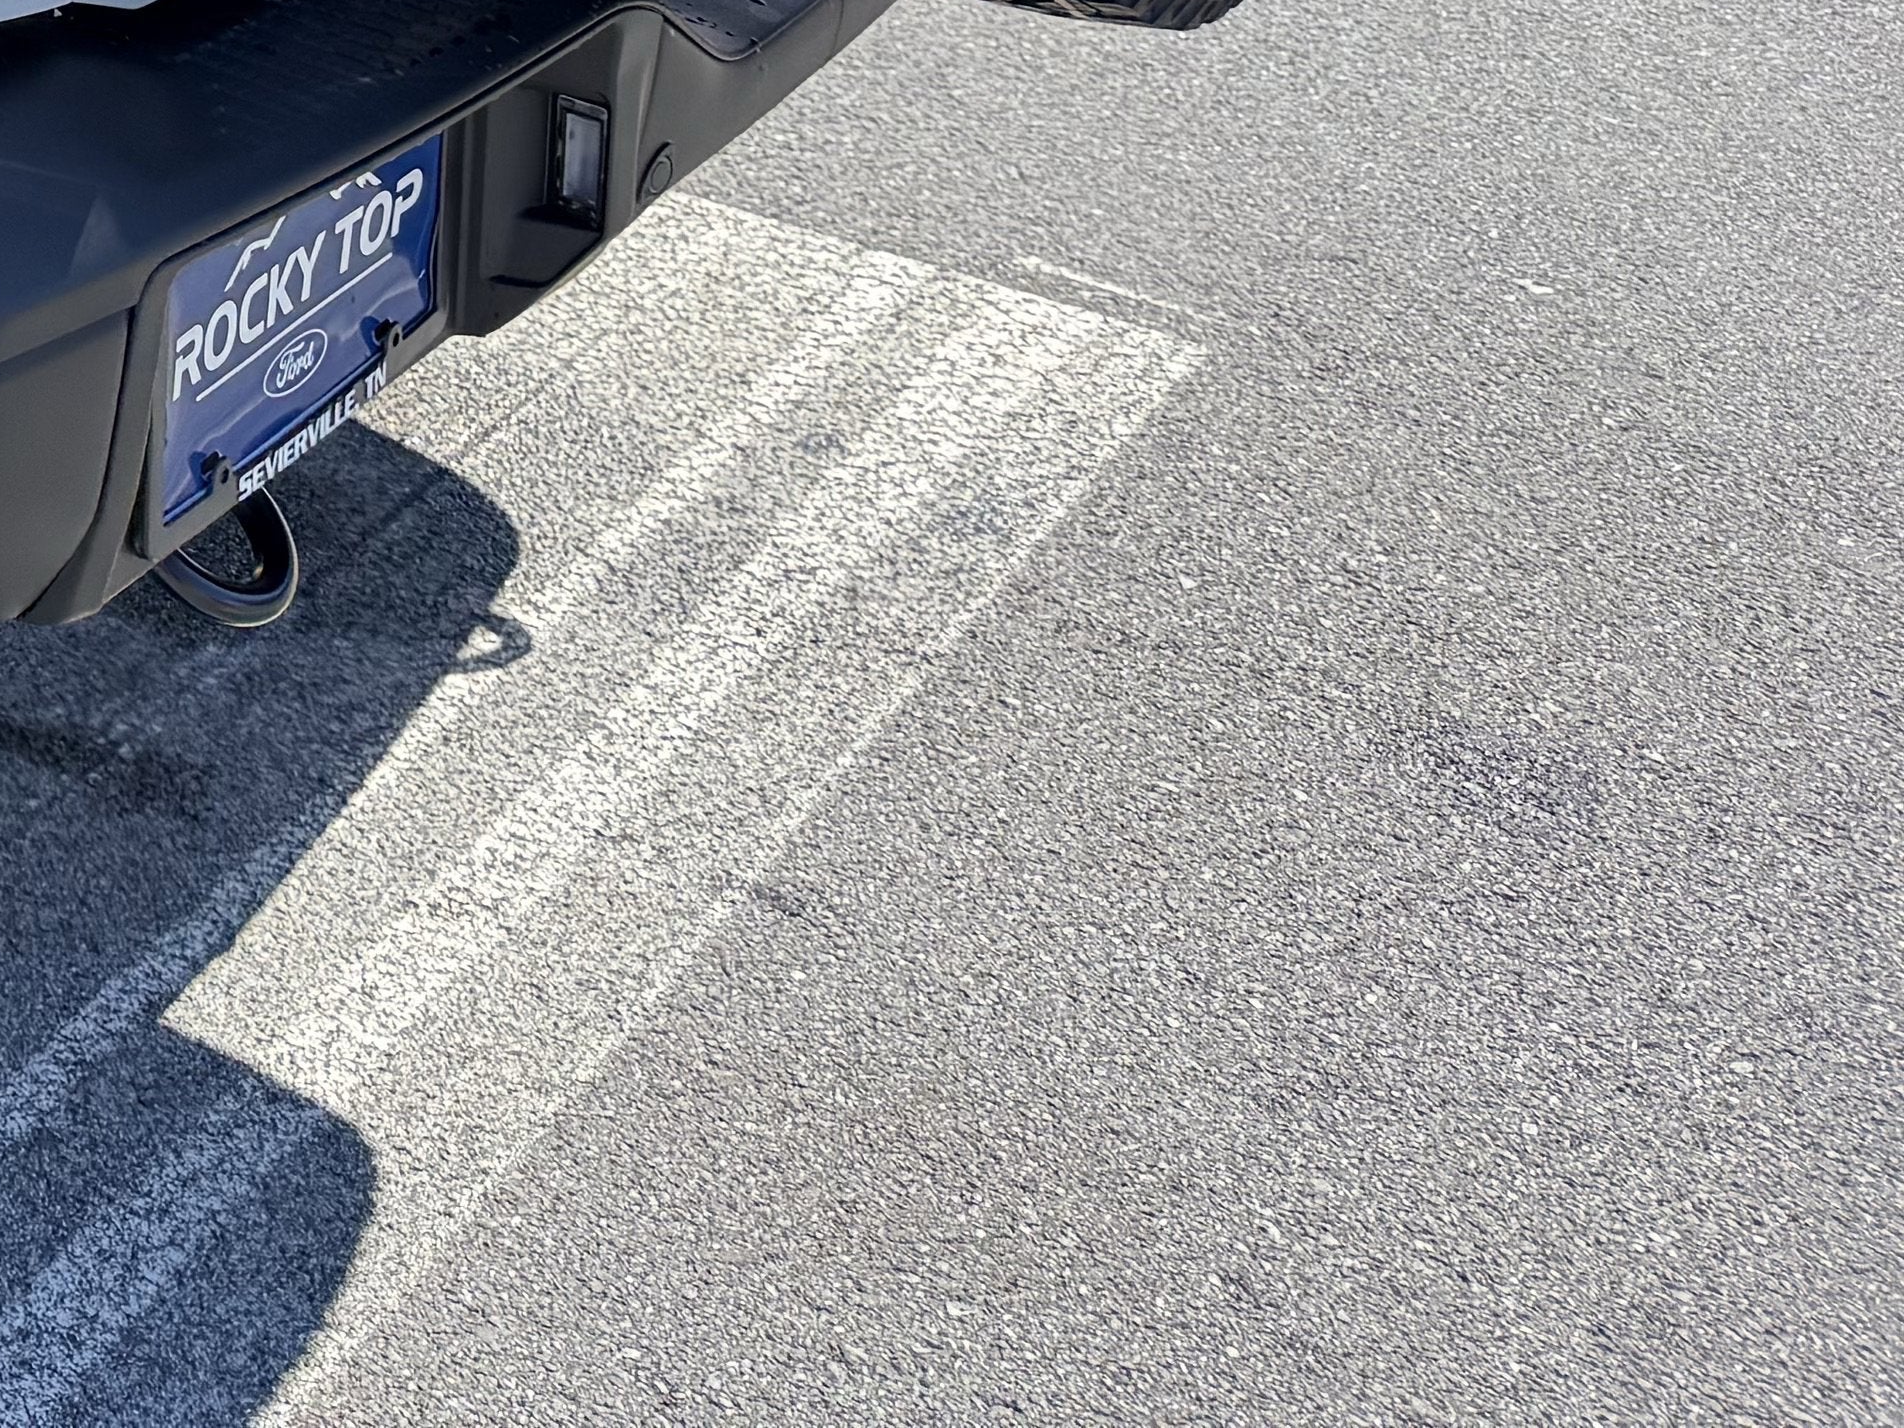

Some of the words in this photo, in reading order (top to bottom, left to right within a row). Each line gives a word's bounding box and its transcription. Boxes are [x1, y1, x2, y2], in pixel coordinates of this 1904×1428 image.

[171, 228, 327, 402] ROCKY
[334, 167, 424, 275] TOP
[238, 392, 359, 502] SEVIERVILLE,
[364, 360, 388, 400] TN
[274, 341, 315, 390] Ford
